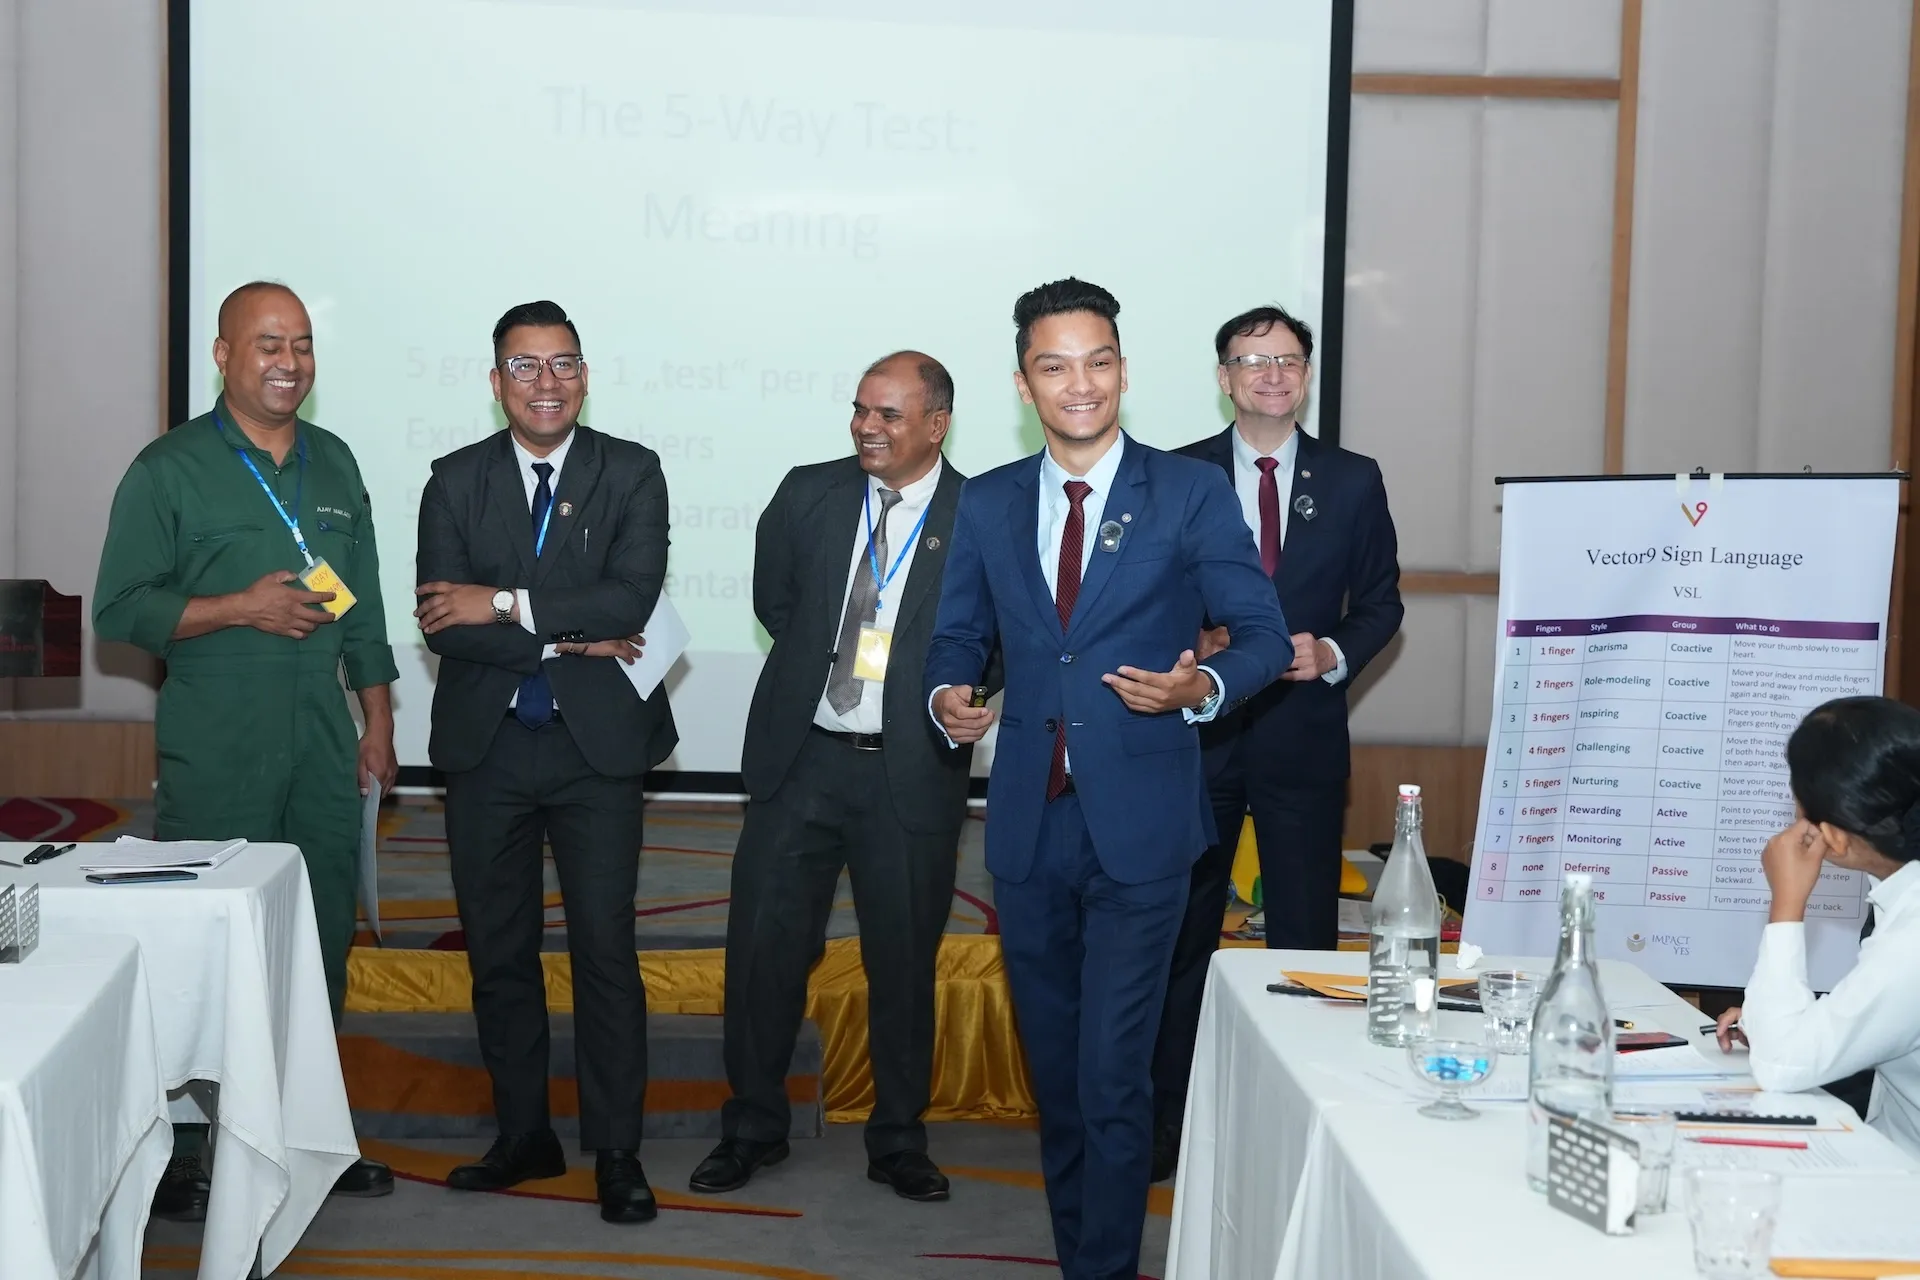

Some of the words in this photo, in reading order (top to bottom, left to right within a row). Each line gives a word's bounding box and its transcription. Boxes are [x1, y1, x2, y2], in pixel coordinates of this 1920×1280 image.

[541, 83, 643, 140] The
[663, 92, 838, 158] 5-Way
[853, 101, 978, 155] Test:
[642, 190, 882, 260] Meaning
[406, 346, 427, 379] 5
[611, 354, 630, 386] 1
[760, 367, 820, 401] per
[1586, 547, 1657, 566] Vector9
[1661, 546, 1703, 567] Sign
[1710, 547, 1803, 570] Language
[311, 569, 329, 589] AJAY
[1673, 586, 1702, 599] VSL
[1535, 625, 1562, 634] Fingers
[1590, 623, 1608, 632] Style
[1672, 620, 1697, 631] Group
[1735, 622, 1757, 631] What
[1759, 624, 1768, 632] to
[1769, 624, 1780, 632] do
[1540, 647, 1546, 655] 1
[1548, 646, 1575, 657] finger
[1588, 643, 1628, 653] Charisma
[1671, 643, 1713, 653] Coactive
[1734, 640, 1756, 649] Move
[1758, 642, 1778, 651] your
[1780, 642, 1803, 651] thumb
[1805, 644, 1829, 653] slowly
[1841, 646, 1859, 655] your
[1733, 650, 1756, 659] heart.
[1584, 675, 1651, 687] Role-modeling
[1668, 677, 1710, 687] Coactive
[1732, 668, 1754, 677] Move
[1755, 670, 1773, 679] your
[1775, 672, 1796, 680] index
[1798, 672, 1812, 681] and
[1814, 673, 1842, 683] middle
[1843, 674, 1870, 685] fingers
[1513, 681, 1519, 689] 2
[1543, 679, 1574, 690] fingers
[1731, 680, 1759, 688] toward
[1760, 681, 1775, 689] and
[1776, 684, 1797, 693] away
[1799, 683, 1819, 692] from
[1820, 686, 1838, 694] your
[1839, 685, 1862, 695] body,
[1730, 691, 1751, 700] again
[1752, 691, 1767, 699] and
[1769, 693, 1791, 702] again.
[1510, 714, 1516, 722] 3
[1540, 712, 1570, 723] fingers
[1580, 709, 1619, 719] Inspiring
[1665, 711, 1707, 721] Coactive
[1728, 708, 1749, 716] Place
[1750, 710, 1768, 718] your
[1770, 710, 1798, 720] thumb,
[1728, 719, 1754, 728] fingers
[1755, 720, 1779, 730] gently
[1726, 737, 1748, 745] Move
[1750, 737, 1763, 745] the
[1537, 745, 1566, 756] fingers
[1576, 743, 1631, 754] Challenging
[1662, 745, 1704, 755] Coactive
[1735, 748, 1752, 756] both
[1755, 749, 1778, 757] hands
[1724, 759, 1742, 767] then
[1743, 760, 1767, 769] apart,
[1502, 780, 1508, 788] 5
[1533, 778, 1561, 789] fingers
[1572, 776, 1619, 787] Nurturing
[1659, 779, 1702, 790] Coactive
[1723, 777, 1745, 785] Move
[1745, 779, 1764, 788] your
[1766, 781, 1786, 789] open
[1722, 790, 1737, 798] you
[1752, 789, 1784, 799] offering
[1498, 807, 1505, 815] 6
[1521, 807, 1527, 815] 6
[1529, 805, 1558, 817] fingers
[1569, 805, 1621, 817] Rewarding
[1656, 808, 1688, 818] Active
[1720, 806, 1741, 814] Point
[1752, 809, 1770, 817] your
[1772, 810, 1792, 818] open
[1734, 818, 1776, 828] presenting
[1495, 835, 1501, 843] 7
[1518, 835, 1524, 843] 7
[1526, 834, 1554, 845] fingers
[1567, 834, 1622, 846] Monitoring
[1654, 837, 1686, 847] Active
[1719, 835, 1741, 843] Move
[1742, 836, 1757, 844] two
[1490, 863, 1497, 871] 8
[1522, 863, 1544, 872] none
[1564, 863, 1611, 875] Deferring
[1652, 866, 1689, 877] Passive
[1715, 865, 1737, 873] Cross
[1739, 867, 1756, 875] your
[1715, 876, 1755, 885] backward.
[1833, 874, 1850, 882] step
[1487, 887, 1494, 895] 9
[1519, 887, 1541, 896] none
[1650, 891, 1687, 902] Passive
[1714, 895, 1731, 904] Turn
[1733, 896, 1761, 905] around
[1823, 903, 1844, 911] back.
[1652, 934, 1691, 946] IMPACT
[1673, 946, 1691, 955] YES
